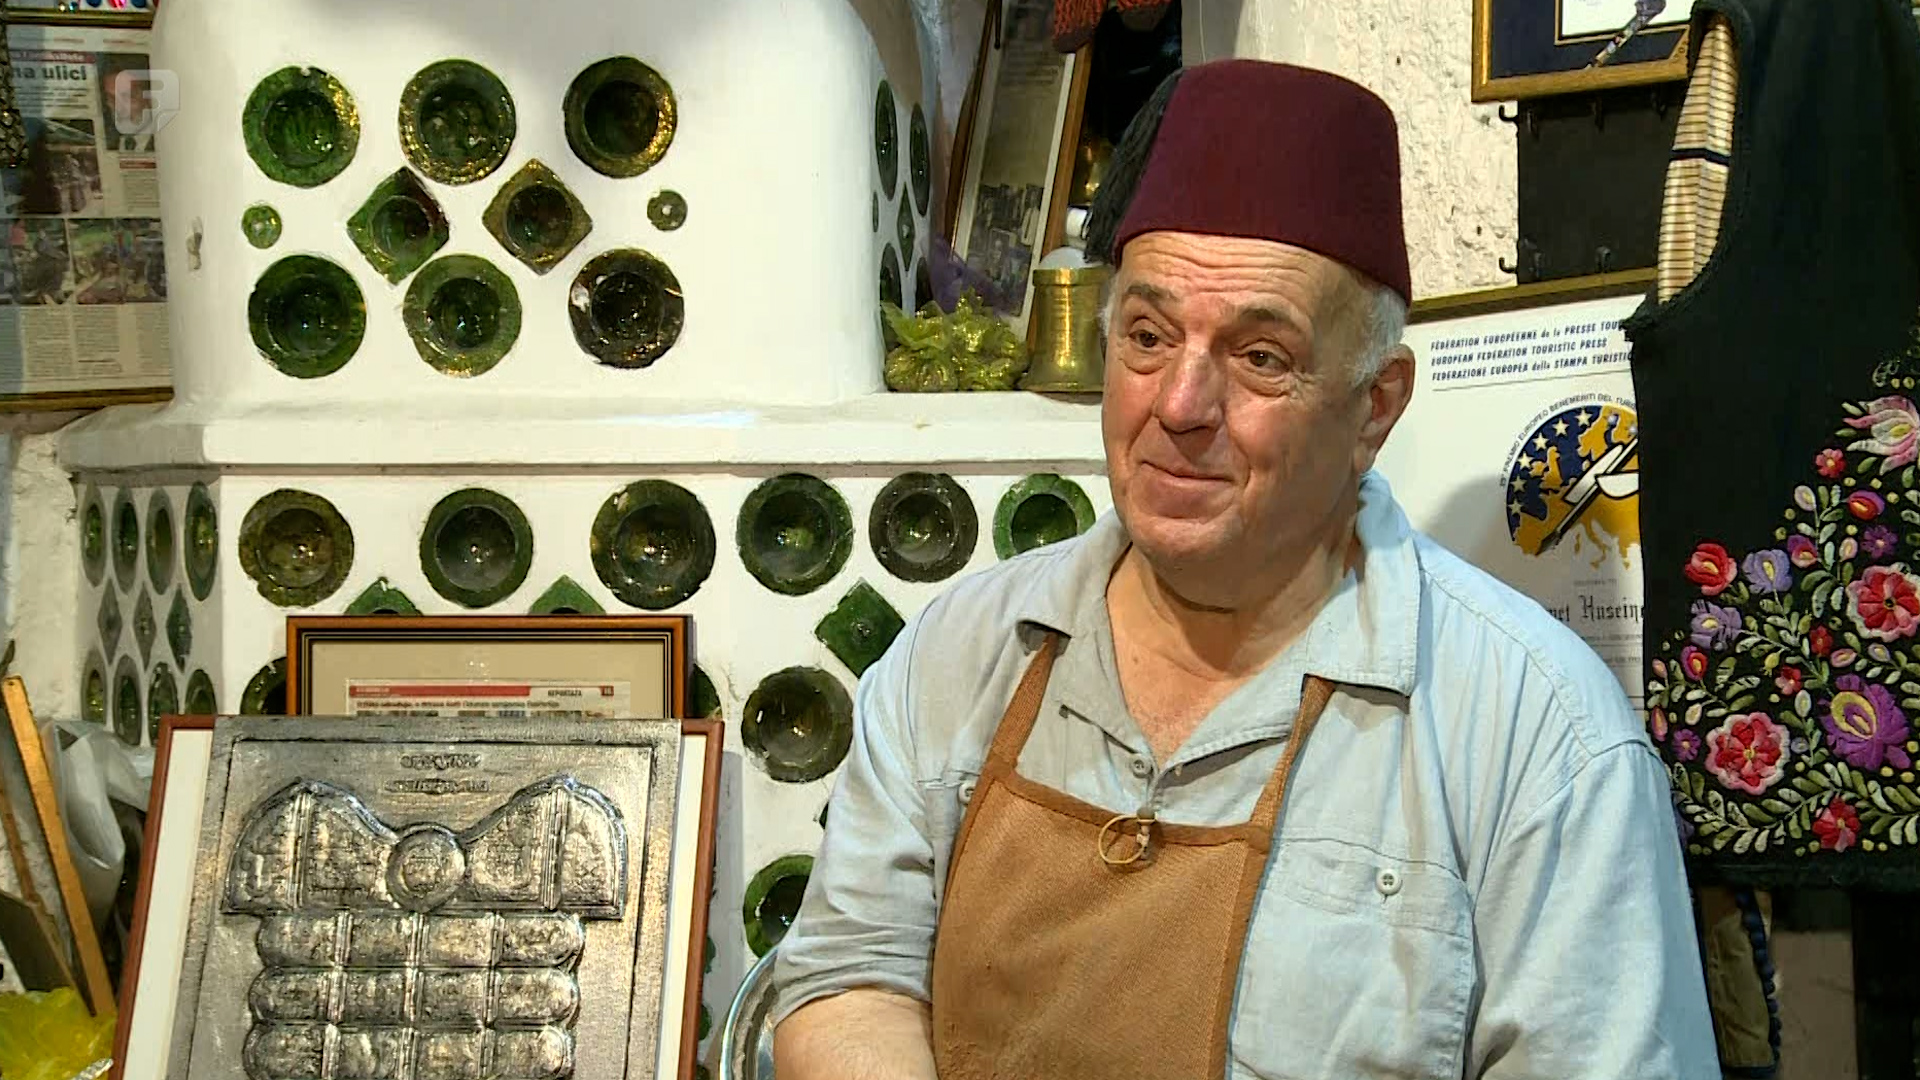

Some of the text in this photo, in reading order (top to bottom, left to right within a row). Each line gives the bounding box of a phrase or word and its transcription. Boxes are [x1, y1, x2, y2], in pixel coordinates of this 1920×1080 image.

[41, 65, 87, 81] ulici
[1564, 323, 1597, 336] PRESSE
[1431, 337, 1607, 367] EUROPEAN FEDERATION TOURISTIC PRESS
[1432, 367, 1487, 381] FEDERAZIONE
[1490, 362, 1529, 376] EUROPEA
[1531, 360, 1551, 371] della
[1554, 356, 1588, 369] STAMPA
[1597, 392, 1613, 402] DEL
